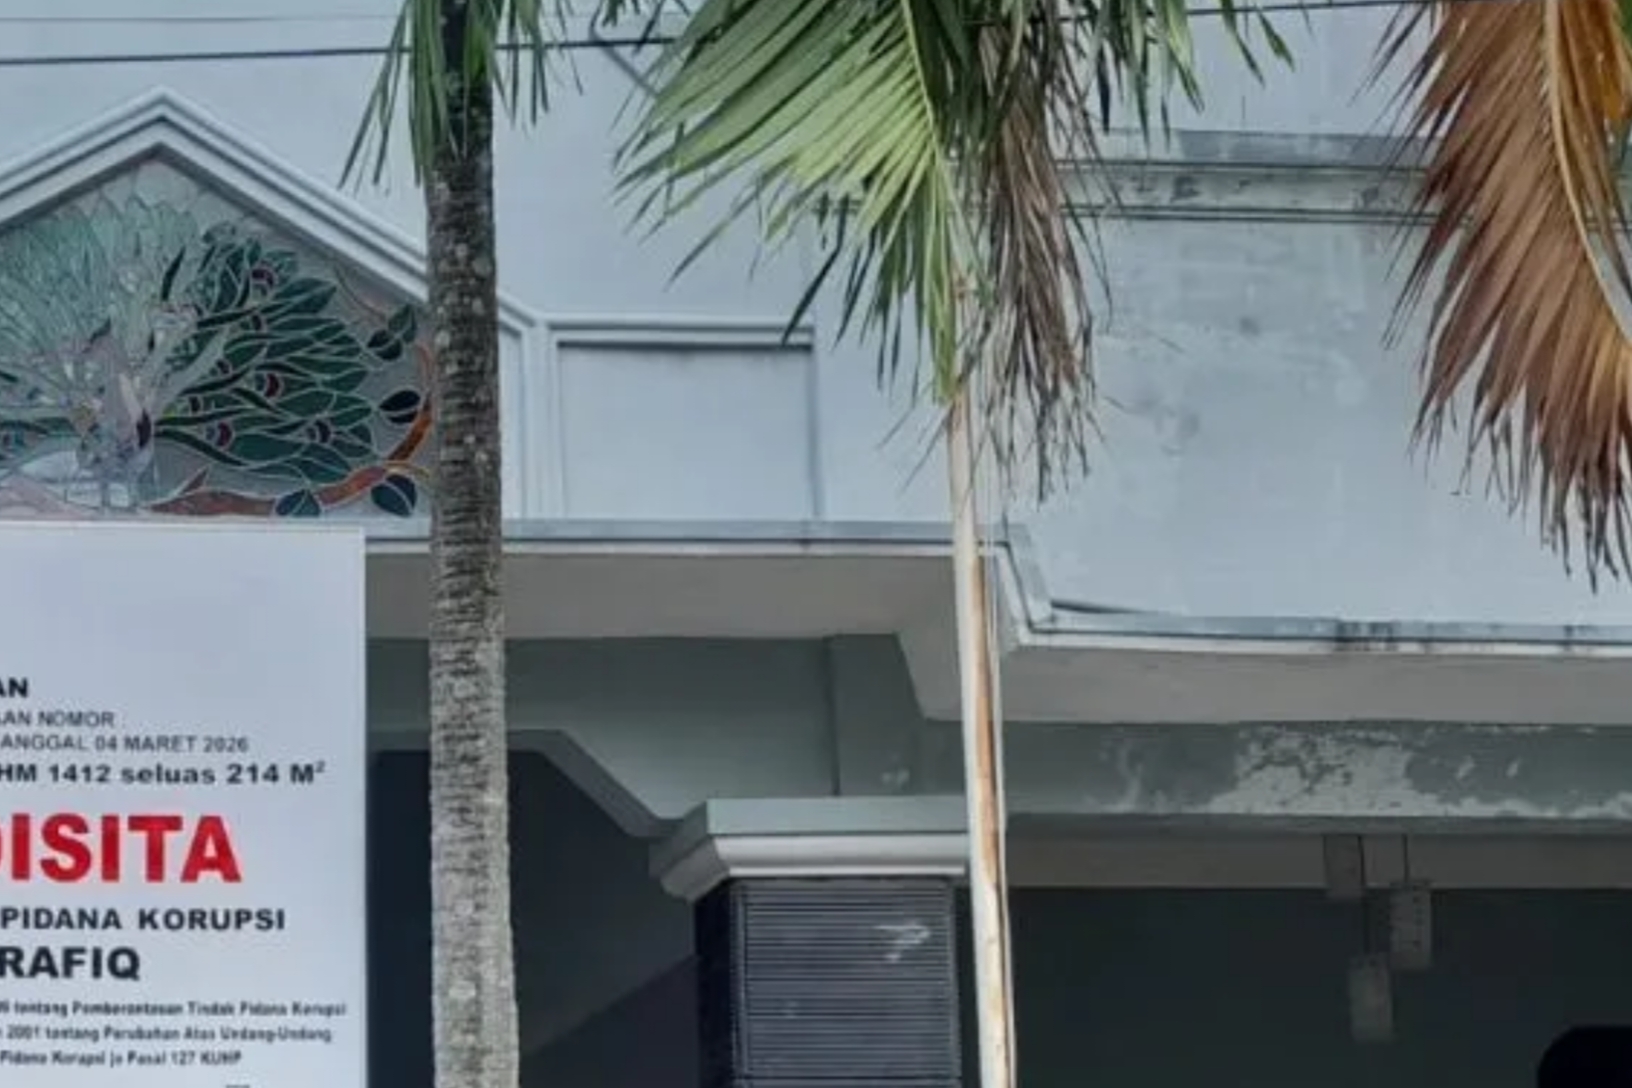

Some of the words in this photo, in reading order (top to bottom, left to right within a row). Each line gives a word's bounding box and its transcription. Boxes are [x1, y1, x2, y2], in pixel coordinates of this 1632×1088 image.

[37, 709, 115, 729] NOMOR
[95, 735, 117, 751] 04
[124, 735, 195, 752] MARET
[204, 736, 249, 752] 2026
[48, 764, 110, 783] 1412
[120, 764, 215, 784] seluas
[227, 765, 279, 783] 214
[0, 906, 123, 930] PIDANA
[138, 908, 285, 932] KORUPSI
